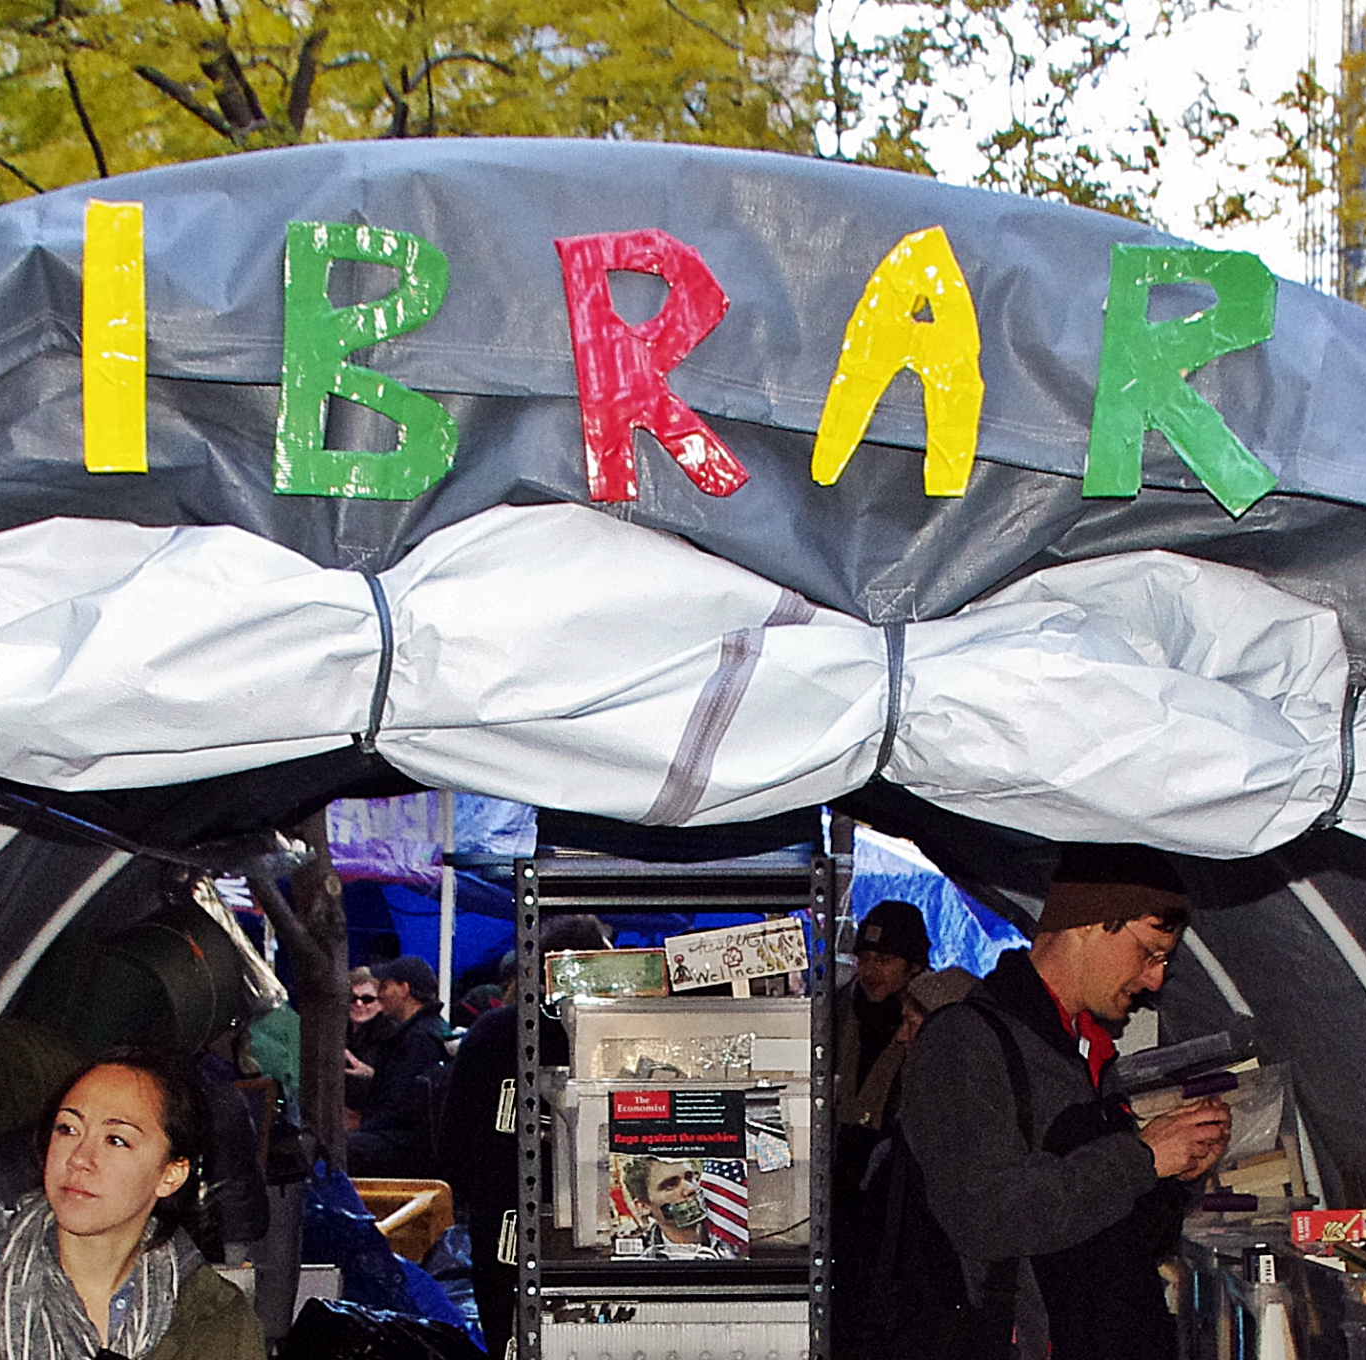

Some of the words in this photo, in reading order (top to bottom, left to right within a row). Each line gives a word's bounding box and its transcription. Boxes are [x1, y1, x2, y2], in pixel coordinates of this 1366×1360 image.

[691, 962, 779, 984] Wellness
[635, 1096, 650, 1104] The
[617, 1104, 666, 1113] Economist
[641, 1133, 677, 1145] against
[679, 1132, 695, 1143] the
